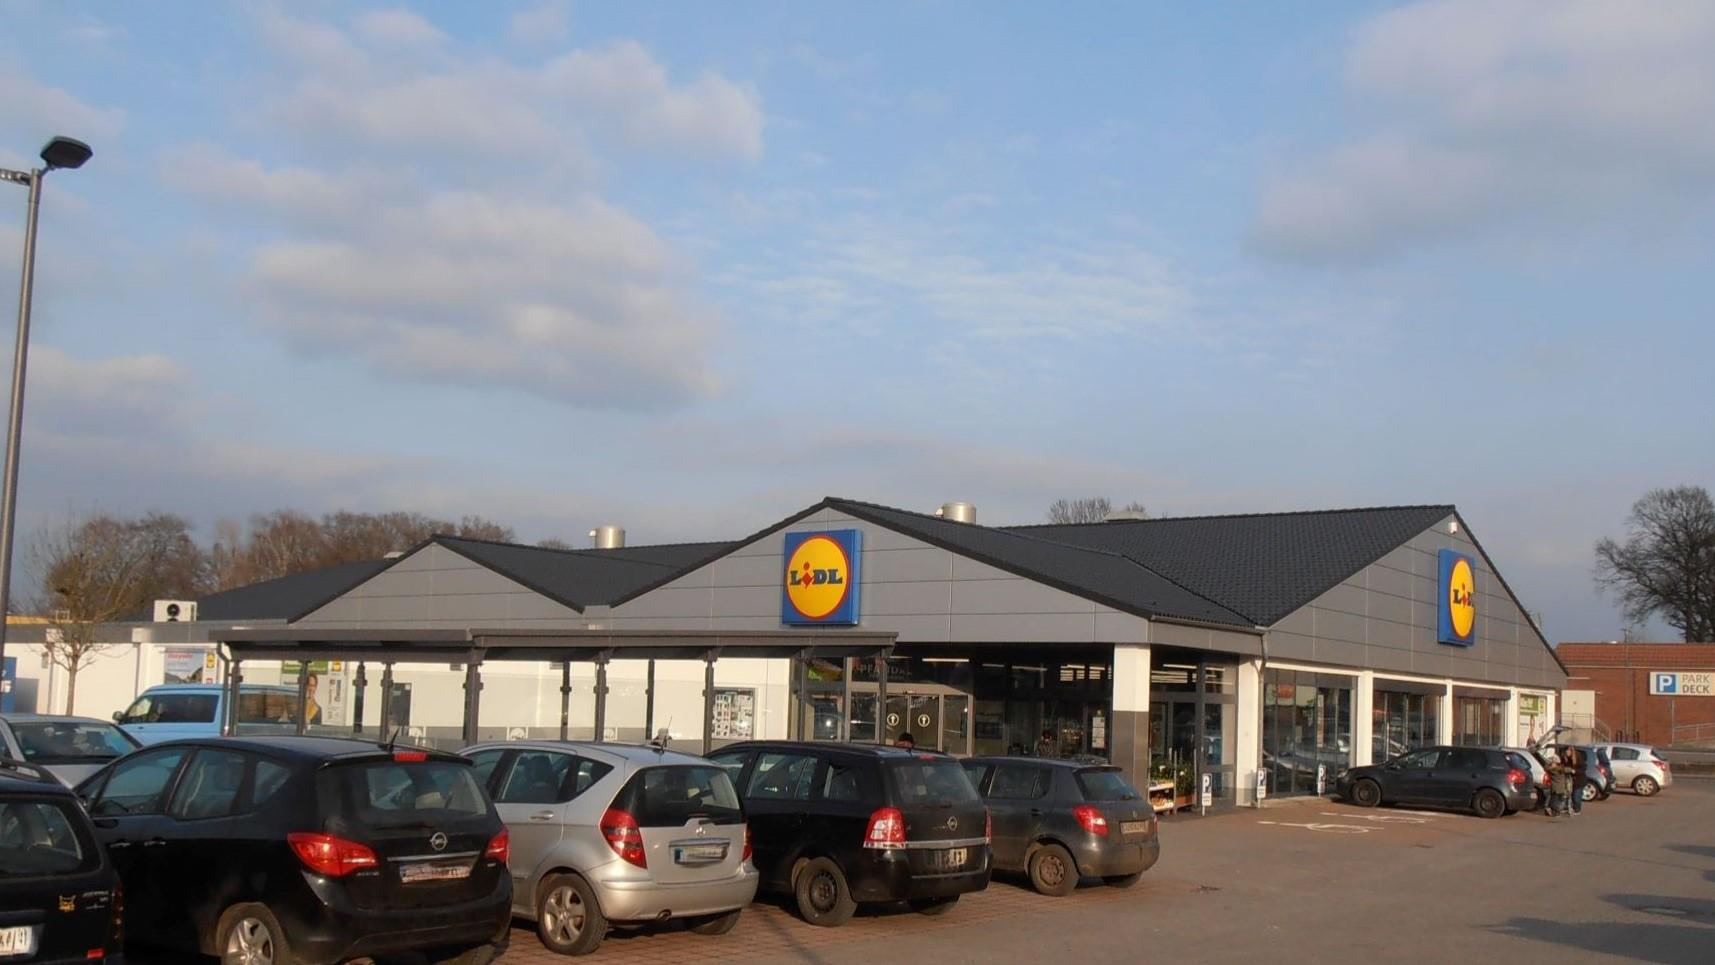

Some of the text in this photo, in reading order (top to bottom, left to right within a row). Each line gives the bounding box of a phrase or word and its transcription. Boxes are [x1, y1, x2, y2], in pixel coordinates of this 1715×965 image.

[1659, 675, 1673, 692] P
[1681, 674, 1711, 683] PARK
[1681, 684, 1711, 693] DECK
[1202, 775, 1210, 793] P
